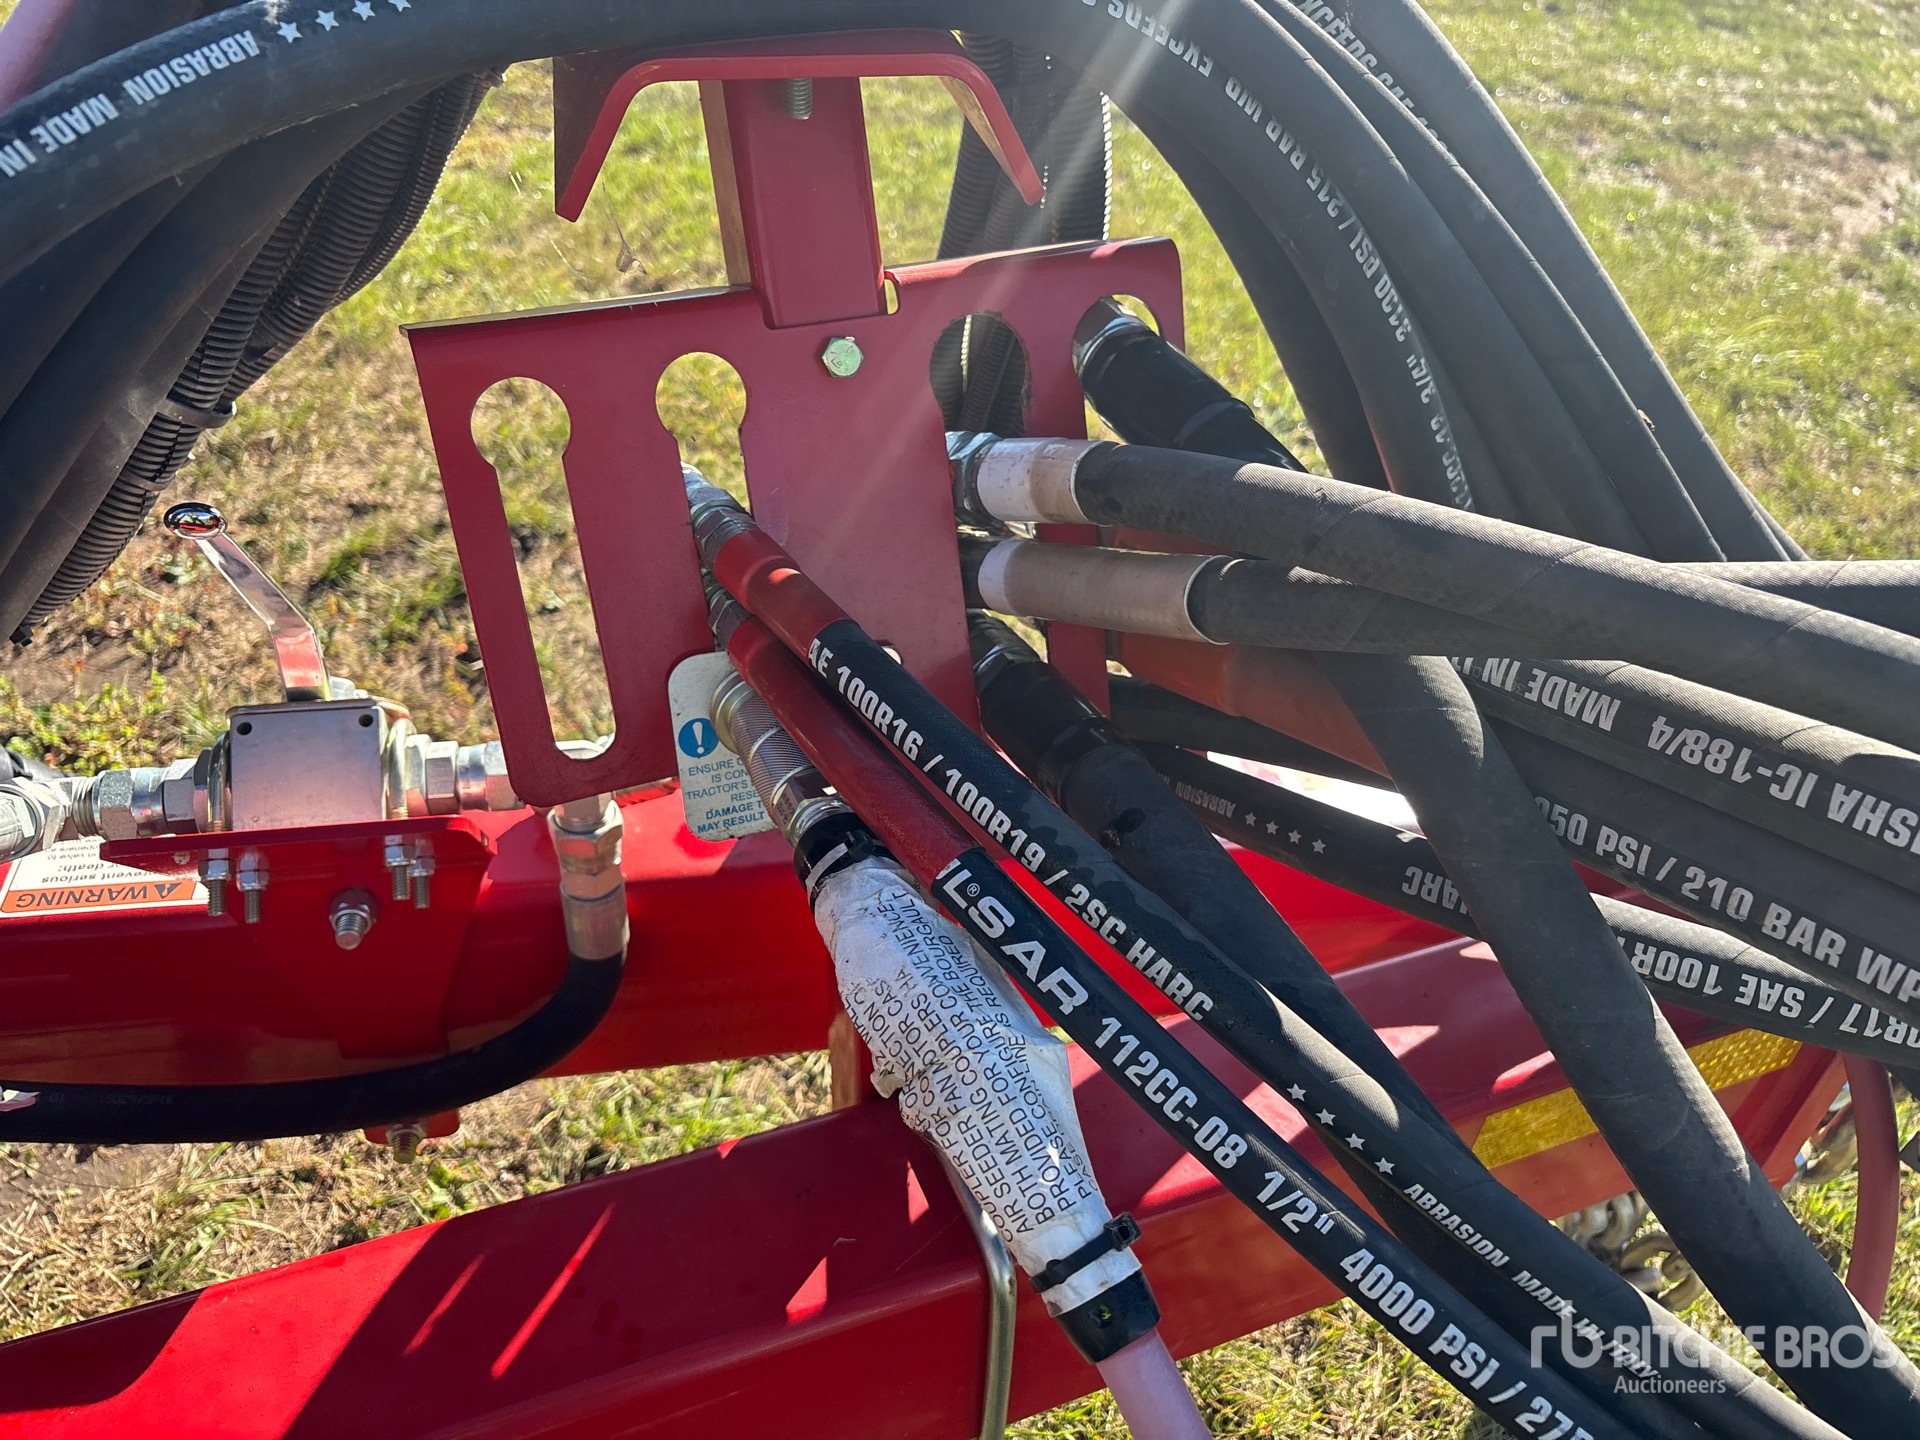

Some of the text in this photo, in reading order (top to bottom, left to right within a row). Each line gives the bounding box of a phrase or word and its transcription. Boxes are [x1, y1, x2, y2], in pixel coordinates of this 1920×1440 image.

[0, 30, 261, 178] ABRASION MADE IN
[1349, 227, 1381, 279] PSI
[688, 757, 735, 777] ENSURE
[711, 774, 722, 784] IS
[1481, 658, 1920, 855] SHA IC-188/4 MADE IN
[687, 779, 748, 800] TRACTOR'S
[705, 804, 751, 821] DAMAGE
[1175, 781, 1237, 818] ABRASION
[697, 811, 765, 835] MAY RESULT
[836, 665, 925, 763] 100R16
[941, 768, 1047, 875] 100R19
[1064, 883, 1127, 945] 2SC
[1126, 938, 1214, 1021] HARC
[41, 873, 97, 884] serious
[58, 862, 104, 873] death:
[16, 885, 148, 908] WARNING
[1595, 825, 1652, 876] PSI
[1680, 866, 1754, 922] 210
[1761, 902, 1847, 968] BAR
[1856, 946, 1920, 1003] WP
[937, 936, 1001, 1007] REQUIRED
[1735, 974, 1805, 1018] SAE
[861, 1001, 936, 1107] CONNECTION
[891, 891, 1092, 1199] PLEASE CONFIGURE THE BOURGAULT
[896, 1012, 947, 1074] MOTOR
[909, 991, 978, 1087] COUPLERS
[948, 1010, 989, 1064] YOUR
[935, 1073, 966, 1116] FAN
[981, 1061, 1017, 1106] FOR
[930, 1106, 959, 1150] FOR
[967, 1085, 1022, 1166] MATING
[955, 1114, 1013, 1200] SEEDER
[1006, 1105, 1077, 1212] PROVIDED
[950, 1149, 1015, 1243] COUPLER
[1002, 1197, 1034, 1237] AIR
[1010, 1164, 1055, 1225] BOTH
[1094, 1016, 1247, 1169] 112CC-08
[1255, 1170, 1335, 1235] 1/2"
[1340, 1248, 1435, 1336] 4000
[1428, 1323, 1500, 1390] PSI
[1404, 1183, 1660, 1381] ABRASION MADE IN ITALY
